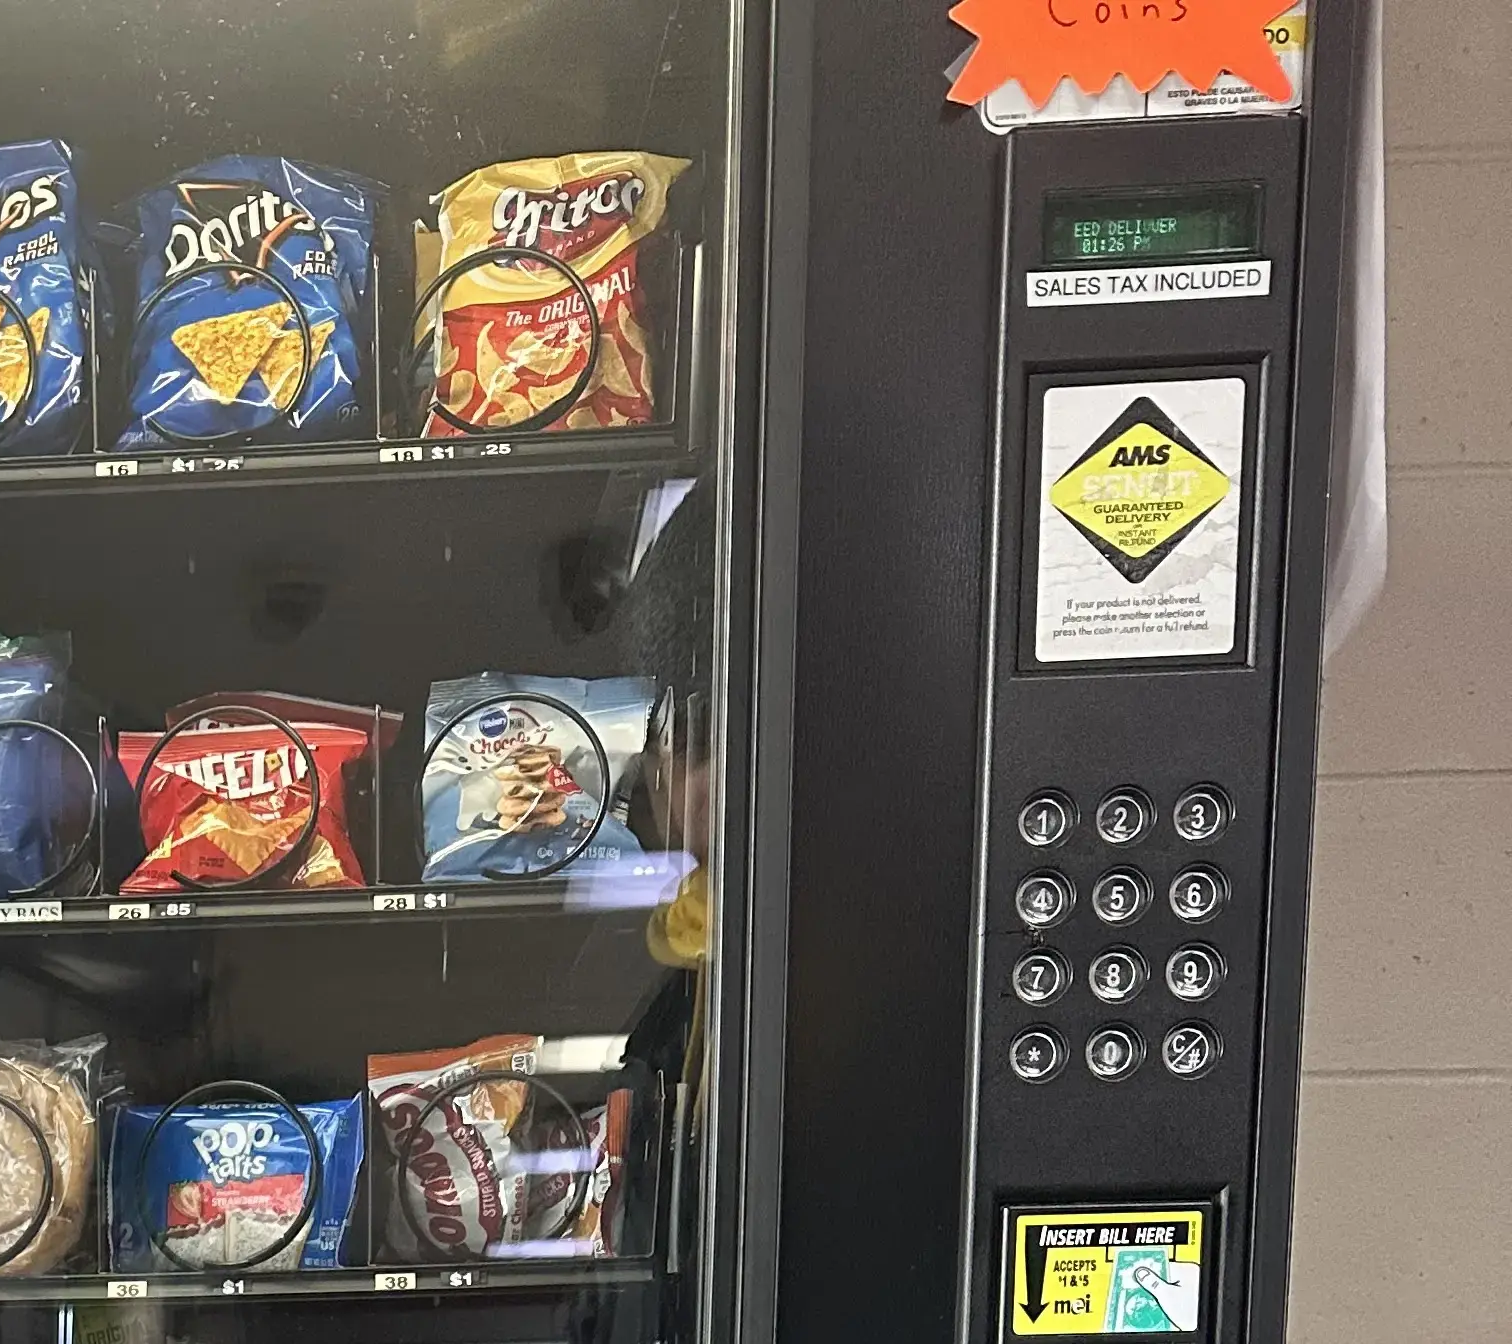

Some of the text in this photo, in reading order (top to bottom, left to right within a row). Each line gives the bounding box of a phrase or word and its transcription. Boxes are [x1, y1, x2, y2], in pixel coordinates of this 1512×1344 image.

[1049, 0, 1189, 27] Coins
[1073, 221, 1101, 238] EED
[3, 230, 59, 268] COOL RANCH
[1082, 236, 1126, 254] 01:26
[1034, 269, 1262, 297] SALES TAX INCLUDED
[505, 310, 533, 327] The
[1109, 444, 1172, 468] AMS
[1093, 501, 1184, 514] GUARANTEED
[1105, 512, 1172, 525] DELIVERY
[1118, 529, 1158, 538] INSTANT
[1118, 537, 1157, 547] REFUND
[1074, 602, 1095, 611] your
[1096, 598, 1131, 610] product
[1141, 594, 1156, 606] not
[1062, 608, 1206, 625] please make another selection or
[1053, 621, 1155, 640] press the coin for
[1037, 810, 1050, 836] 1
[1113, 806, 1128, 832] 2
[1191, 803, 1205, 829] 3
[423, 892, 448, 909] $1
[1034, 887, 1048, 912] 4
[1109, 885, 1125, 910] 5
[1187, 882, 1202, 908] 6
[160, 902, 191, 917] .85
[1030, 965, 1045, 990] 7
[1106, 963, 1122, 988] 8
[1183, 960, 1199, 985] 9
[1103, 1041, 1119, 1066] 0
[207, 1154, 268, 1184] tarts
[1039, 1225, 1096, 1247] INSERT
[1098, 1226, 1130, 1245] BILL
[1134, 1225, 1176, 1244] HERE
[1053, 1259, 1097, 1273] ACCEPTS
[116, 1279, 244, 1297] 36 $1
[384, 1272, 472, 1289] 38 $1
[1069, 1275, 1078, 1287] &
[1054, 1294, 1093, 1315] mei
